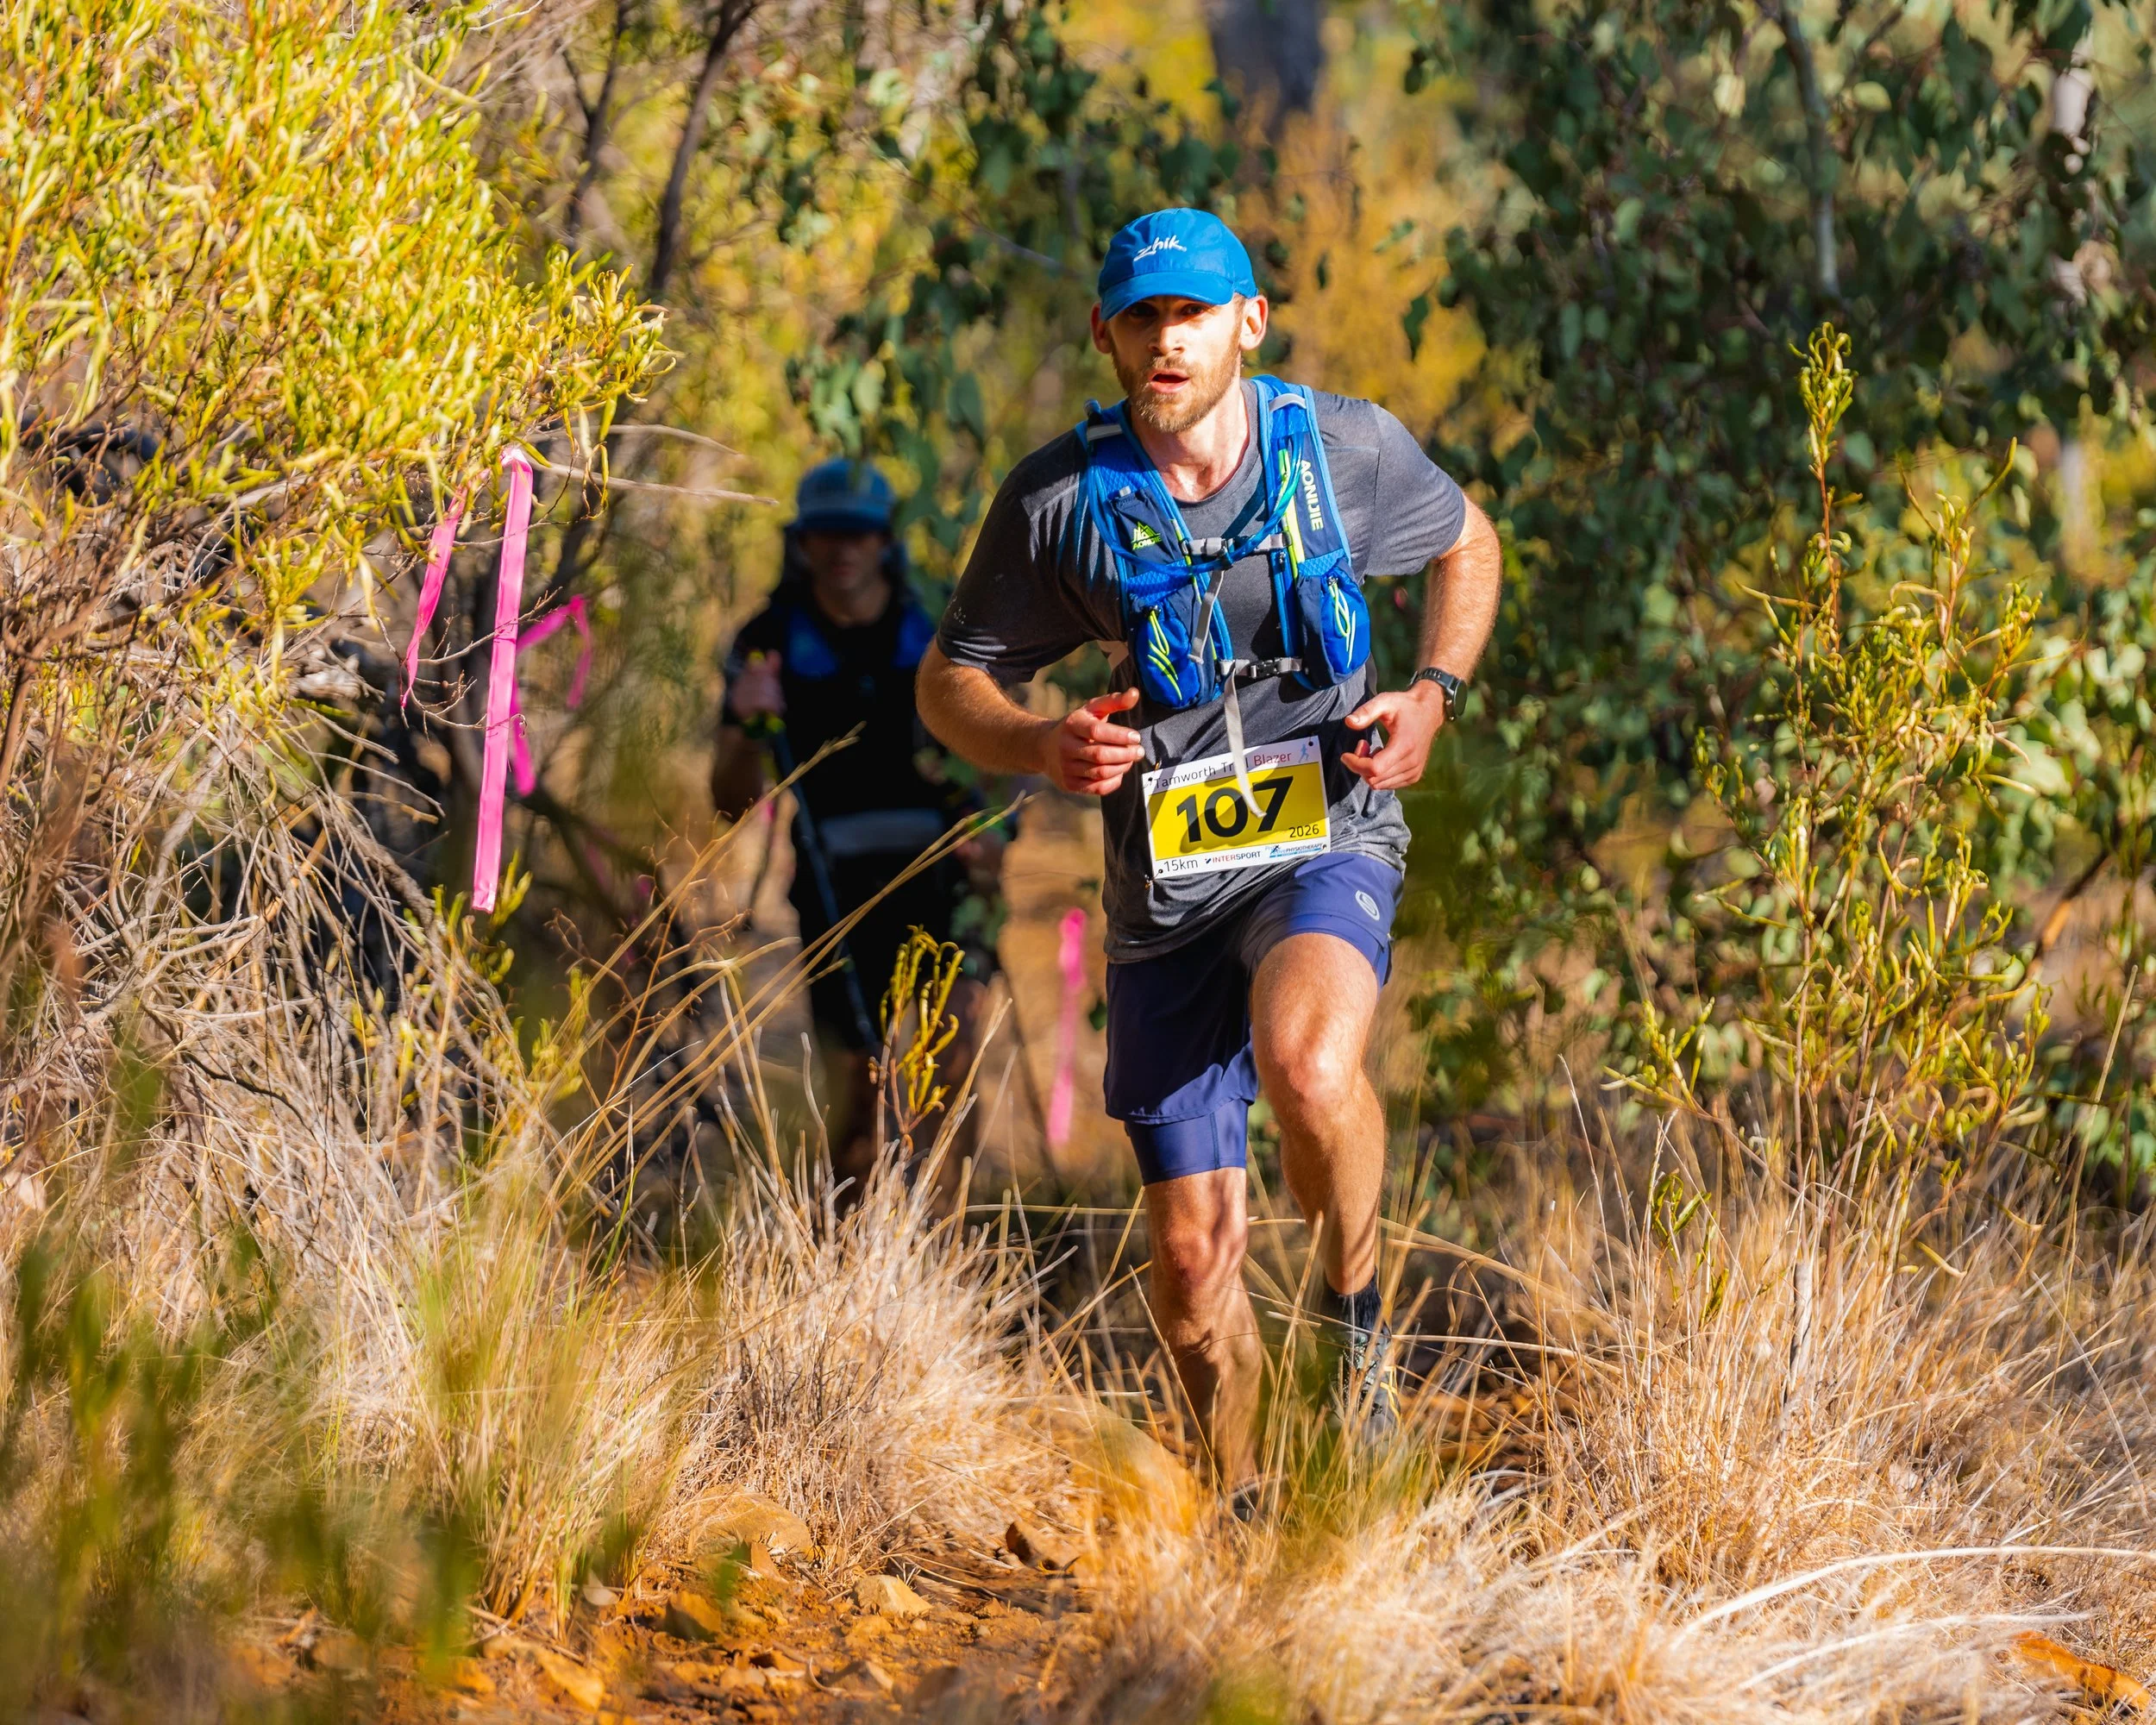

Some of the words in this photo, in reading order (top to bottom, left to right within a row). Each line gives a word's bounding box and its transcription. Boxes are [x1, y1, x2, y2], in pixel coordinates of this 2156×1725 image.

[1300, 460, 1324, 531] AONIJIE
[1154, 766, 1216, 789] Tamworth
[1221, 756, 1249, 773] Trl
[1253, 752, 1292, 766] Blazer
[1176, 776, 1294, 843] 107
[1288, 825, 1319, 838] 2026
[1163, 856, 1199, 873] 15km
[1213, 851, 1261, 862] INTERSPORT
